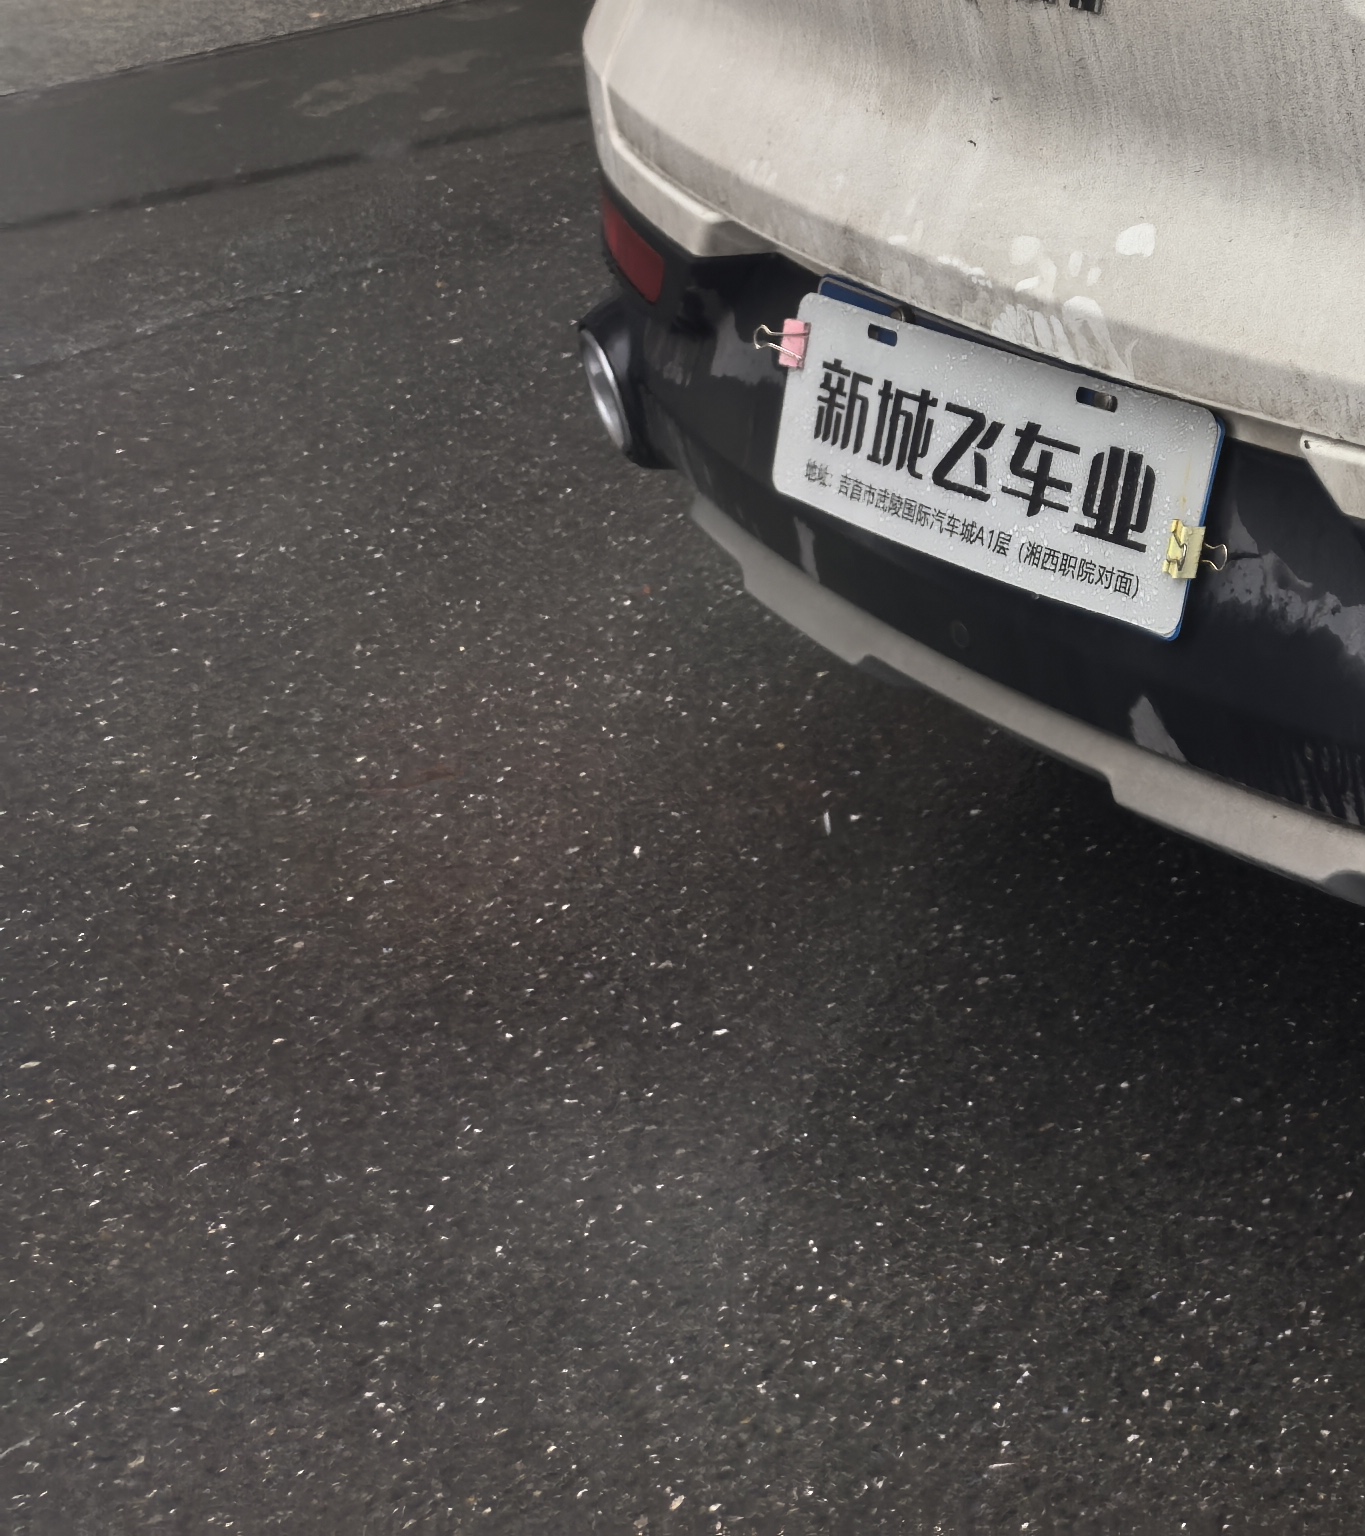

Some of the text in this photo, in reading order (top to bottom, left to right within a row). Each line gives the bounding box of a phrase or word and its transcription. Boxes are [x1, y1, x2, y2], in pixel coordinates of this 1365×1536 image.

[813, 359, 1156, 553] 新城飞车业
